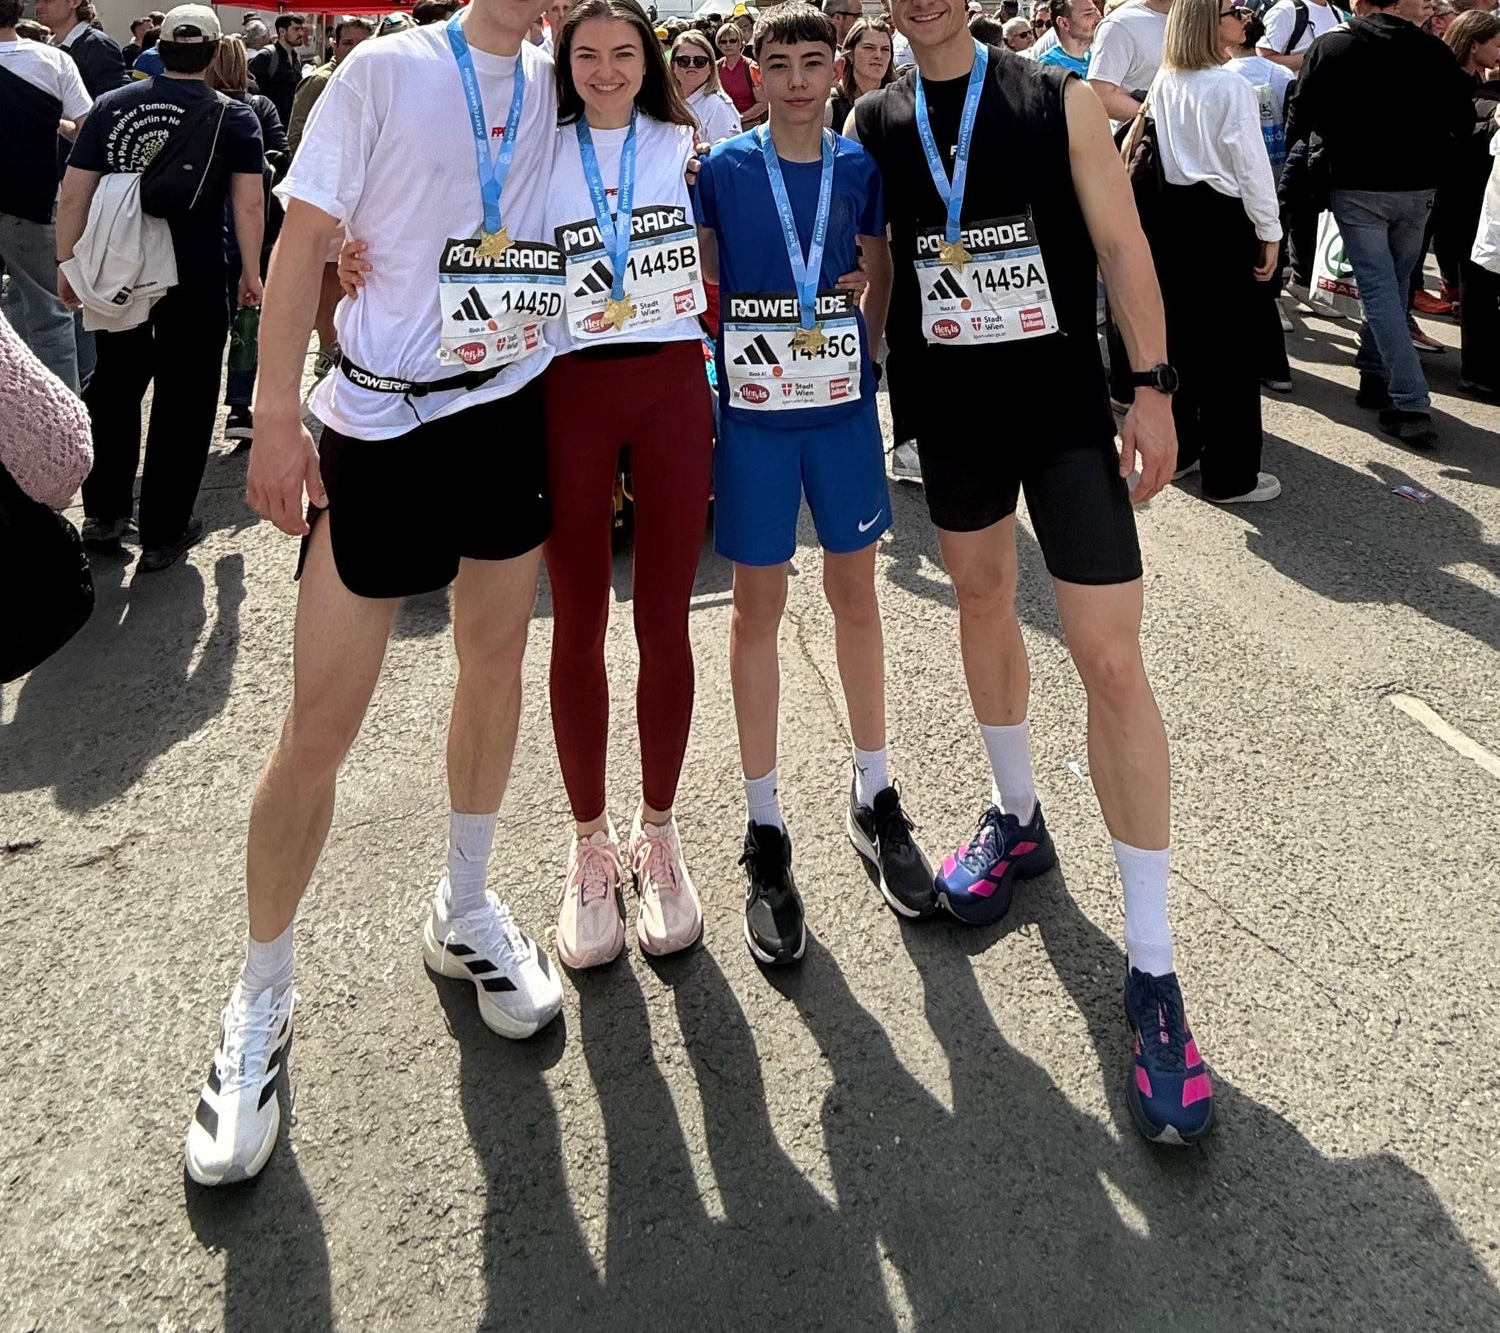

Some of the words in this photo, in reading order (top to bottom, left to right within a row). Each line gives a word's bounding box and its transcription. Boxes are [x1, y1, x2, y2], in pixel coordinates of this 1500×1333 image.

[139, 102, 186, 115] Tomorrow
[464, 67, 484, 136] STAFFELMARATHON
[108, 108, 138, 142] Brighter
[960, 94, 977, 156] STAFFELMARATHON
[118, 134, 131, 157] Paris
[132, 115, 160, 130] Berlin
[106, 142, 115, 150] A
[132, 143, 141, 159] The
[627, 245, 696, 282] 1445B
[972, 263, 1045, 294] 1445A
[1318, 278, 1360, 299] SPAR
[501, 290, 561, 317] 1445D
[640, 300, 658, 310] Stadt
[641, 308, 660, 317] Wien
[984, 315, 1003, 323] Stadt
[935, 324, 959, 337] Hervis
[985, 323, 1004, 331] Wien
[742, 387, 768, 400] Hervis
